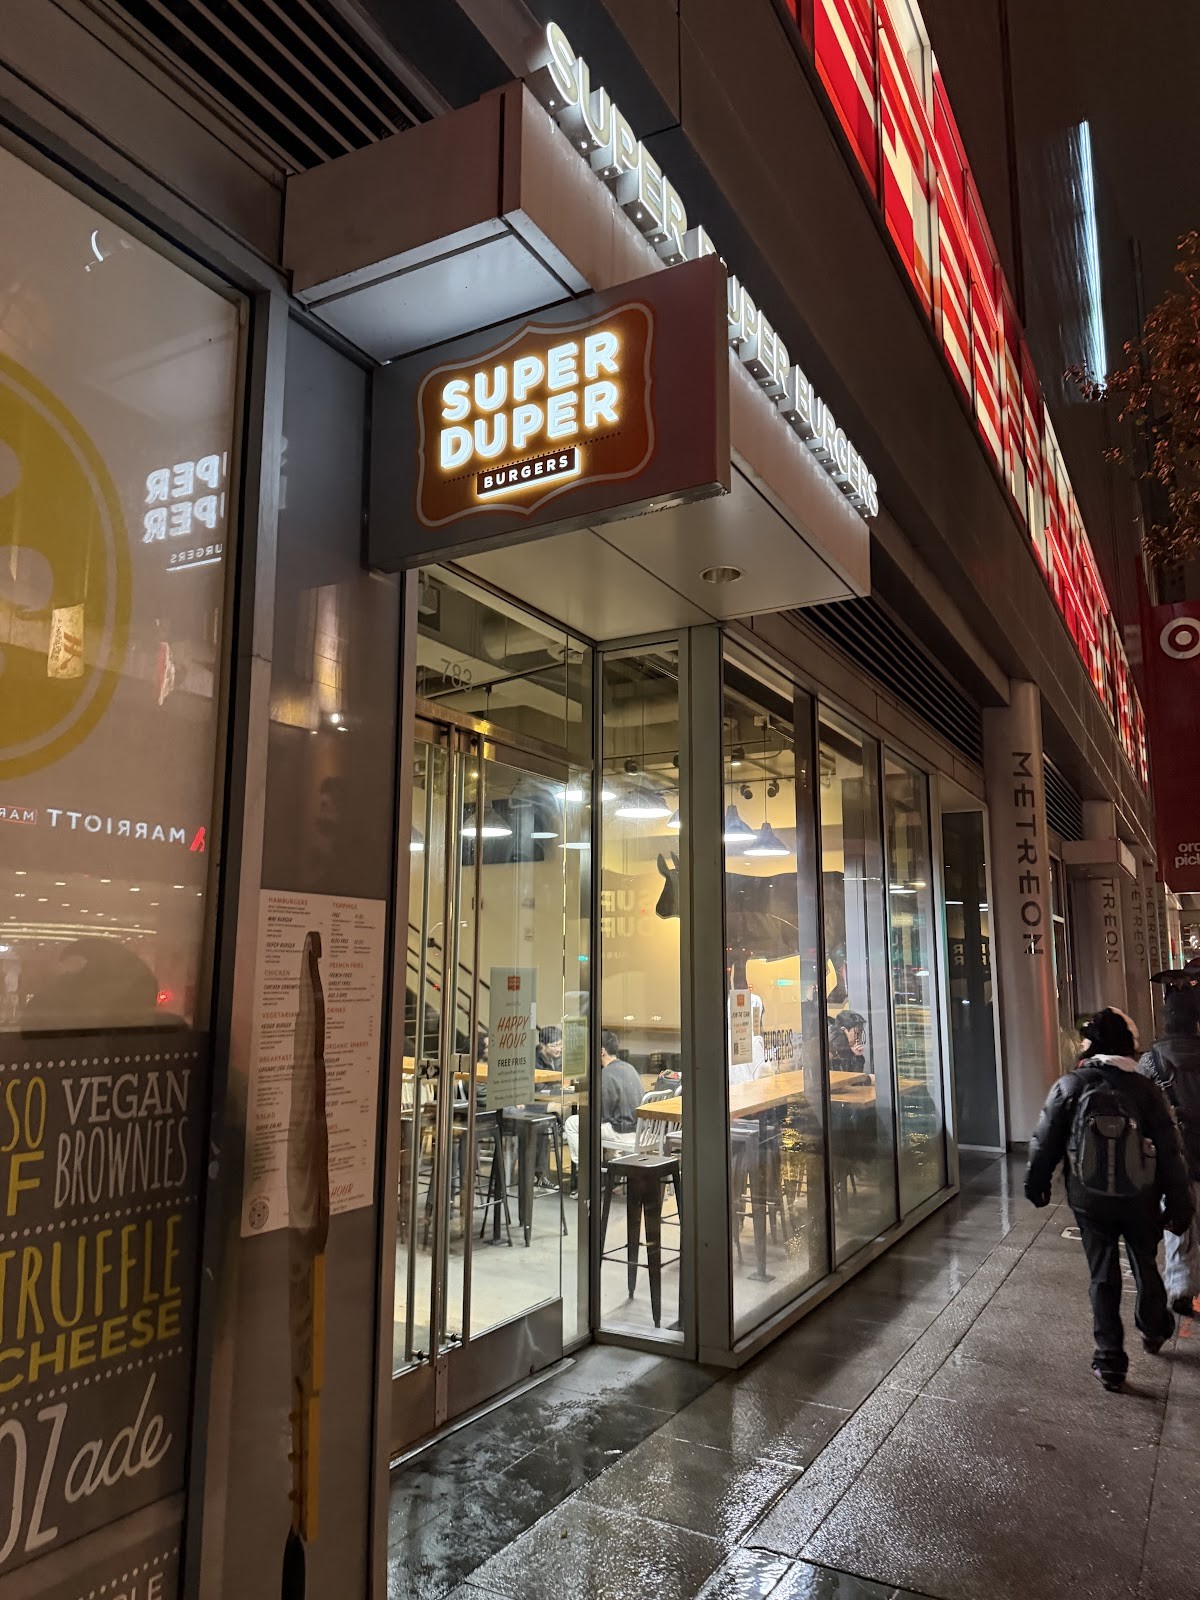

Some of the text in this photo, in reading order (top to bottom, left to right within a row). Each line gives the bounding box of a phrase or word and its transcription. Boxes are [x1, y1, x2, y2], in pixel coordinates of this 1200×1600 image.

[545, 22, 688, 261] SUPER
[795, 364, 878, 517] BURGERS
[441, 331, 620, 421] SUPER
[440, 380, 620, 469] DUPER
[483, 454, 569, 489] BURGERS
[1011, 751, 1044, 956] METREON
[497, 1015, 530, 1033] HAPPY
[497, 1056, 527, 1068] FREE FRIES
[498, 1032, 528, 1049] HOUR
[62, 1069, 191, 1126] VEGAN
[54, 1116, 189, 1209] BROWNIES
[0, 1214, 182, 1342] TRUFFLE
[0, 1299, 182, 1393] CHEESE
